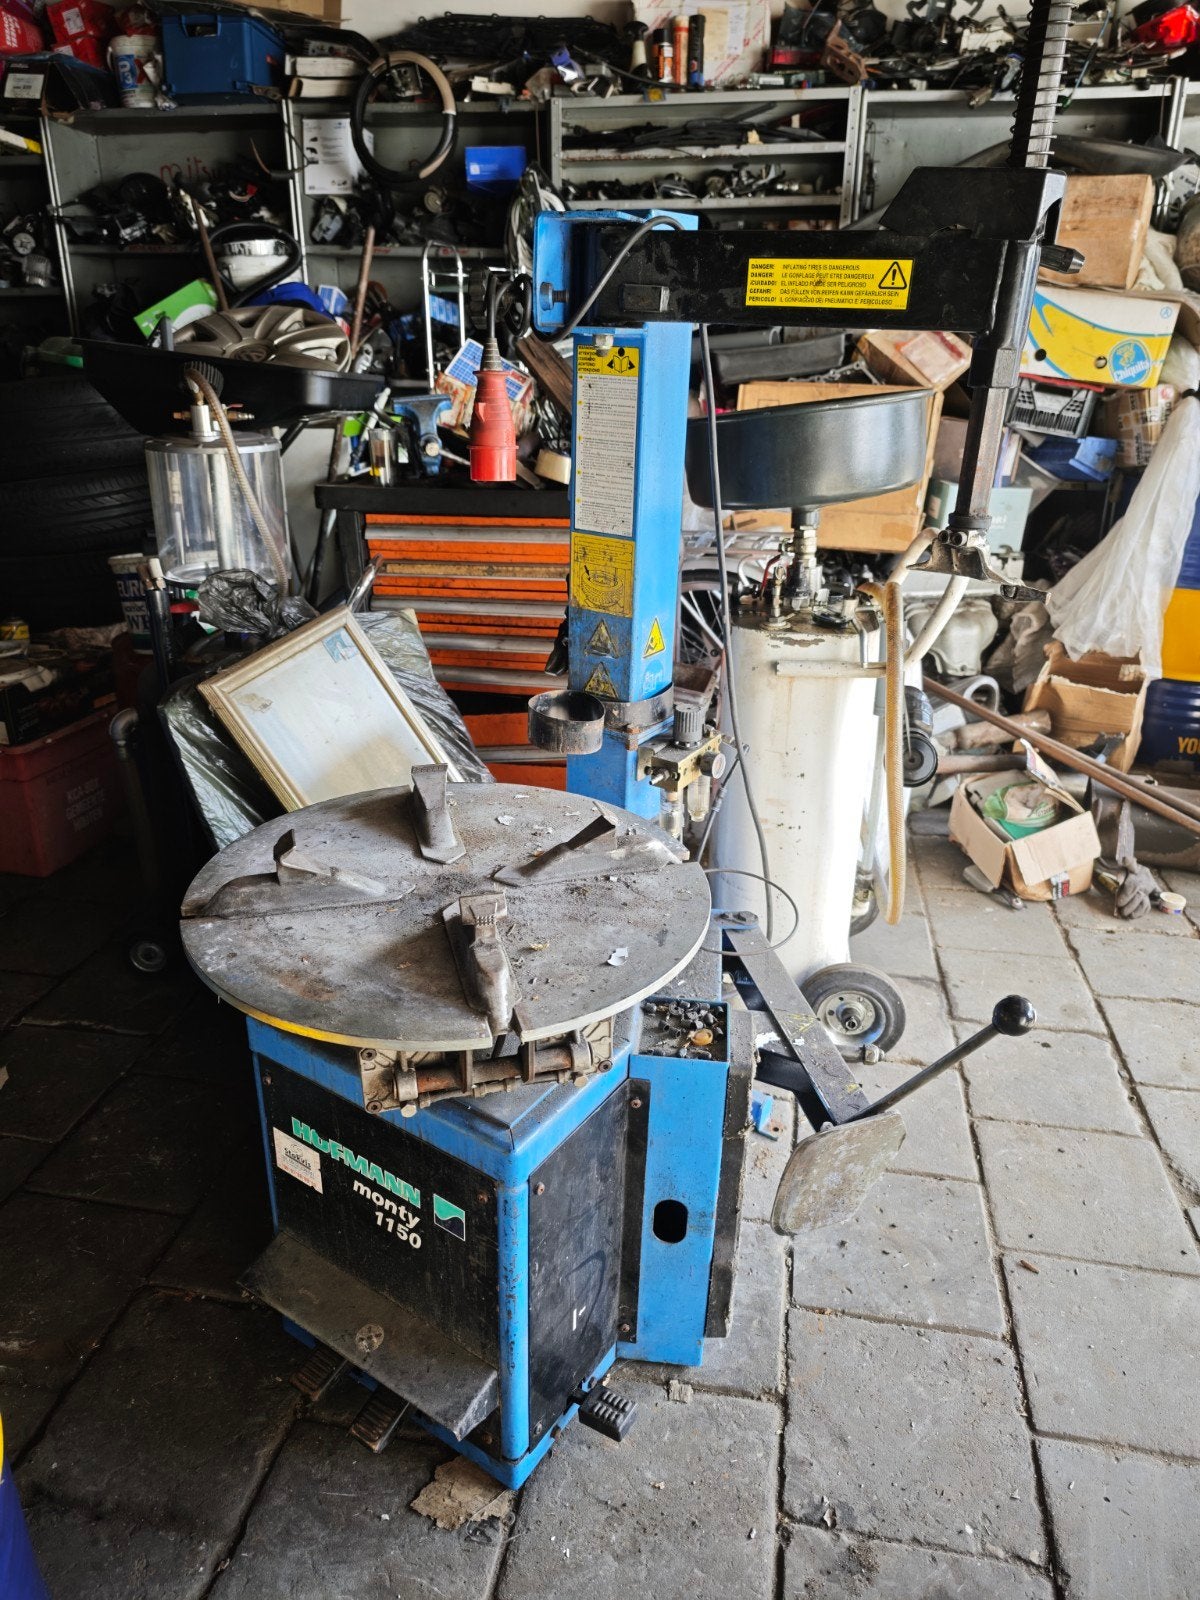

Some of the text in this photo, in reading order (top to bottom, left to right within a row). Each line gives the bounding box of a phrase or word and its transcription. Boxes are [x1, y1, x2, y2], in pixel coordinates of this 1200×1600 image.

[838, 281, 867, 289] PELIGROSO
[1113, 360, 1153, 382] Chiquita
[1178, 736, 1200, 756] YO
[353, 1180, 421, 1229] monty
[375, 1211, 422, 1249] 1150
